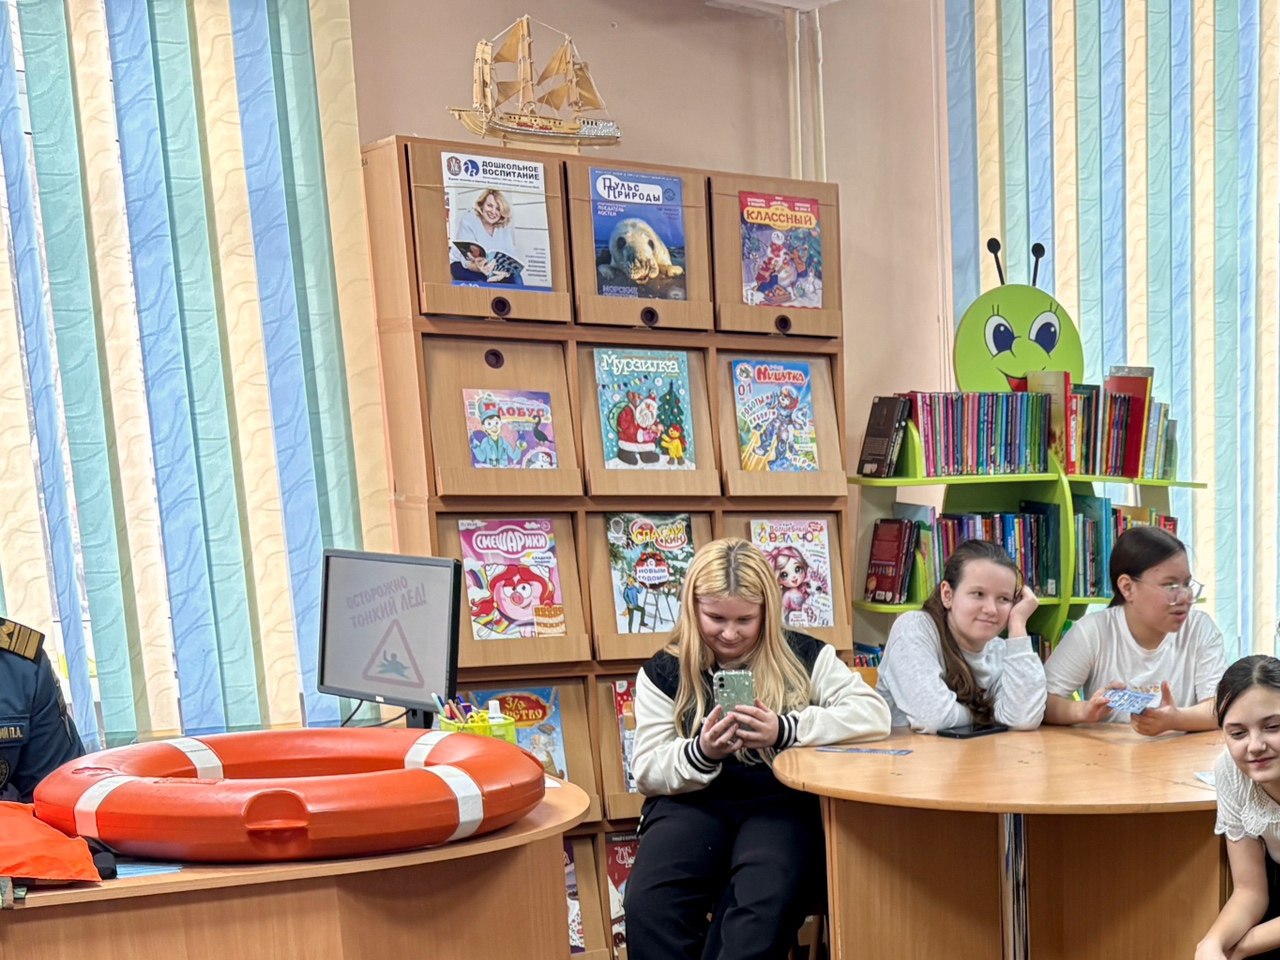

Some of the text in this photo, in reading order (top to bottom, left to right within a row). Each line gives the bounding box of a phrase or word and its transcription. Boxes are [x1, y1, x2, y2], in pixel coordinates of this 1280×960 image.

[482, 161, 539, 173] ДОШКОЛЬНОЕ
[482, 168, 540, 181] ВОСПИТАНИЕ
[746, 210, 813, 226] КЛАССНЫЙ
[602, 354, 680, 375] Мурзилка
[476, 531, 546, 552] СМЕШАРИКИ
[638, 567, 666, 575] НОВЫМ
[346, 576, 408, 609] ОСТОРОЖНО
[350, 582, 427, 628] ТОНКИЙ ЛЕД!
